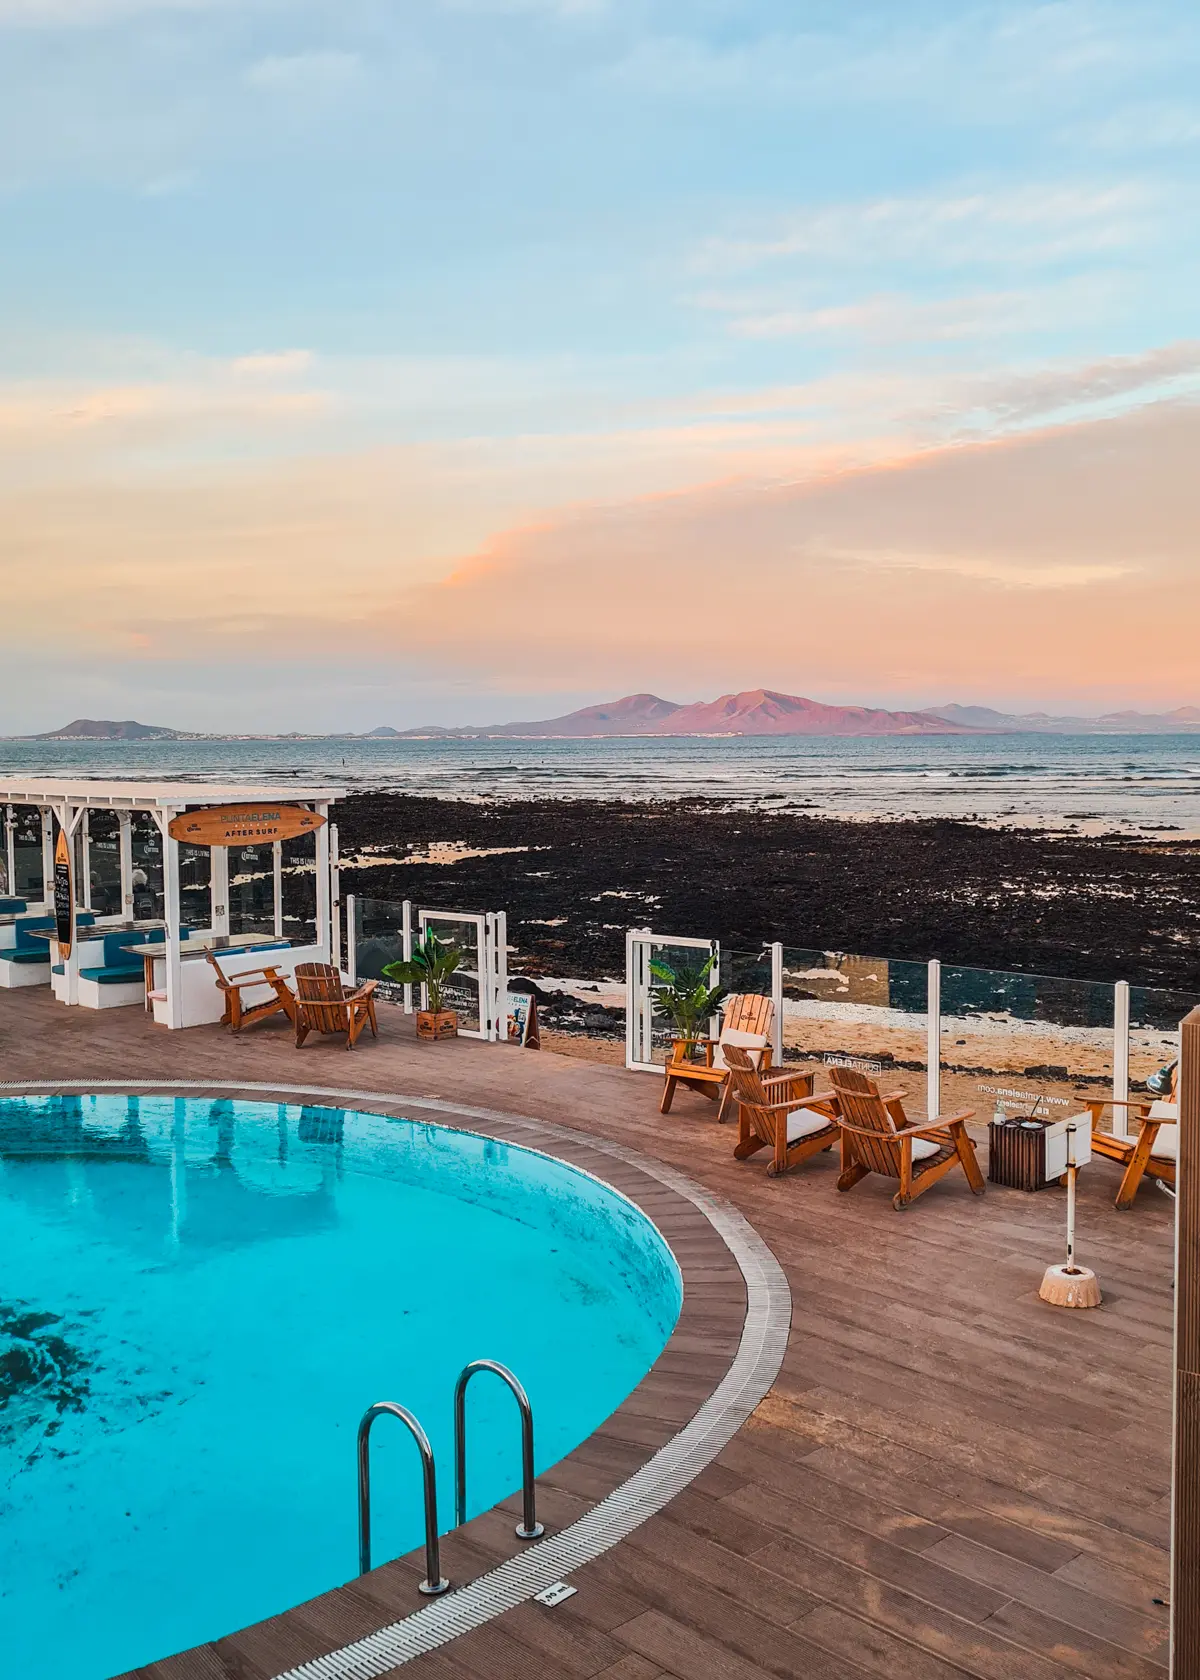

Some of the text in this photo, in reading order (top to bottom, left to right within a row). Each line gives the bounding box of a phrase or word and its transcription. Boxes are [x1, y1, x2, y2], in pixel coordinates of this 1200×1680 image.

[225, 829, 253, 837] AFTER
[144, 845, 159, 855] Corona
[241, 851, 258, 861] Corona
